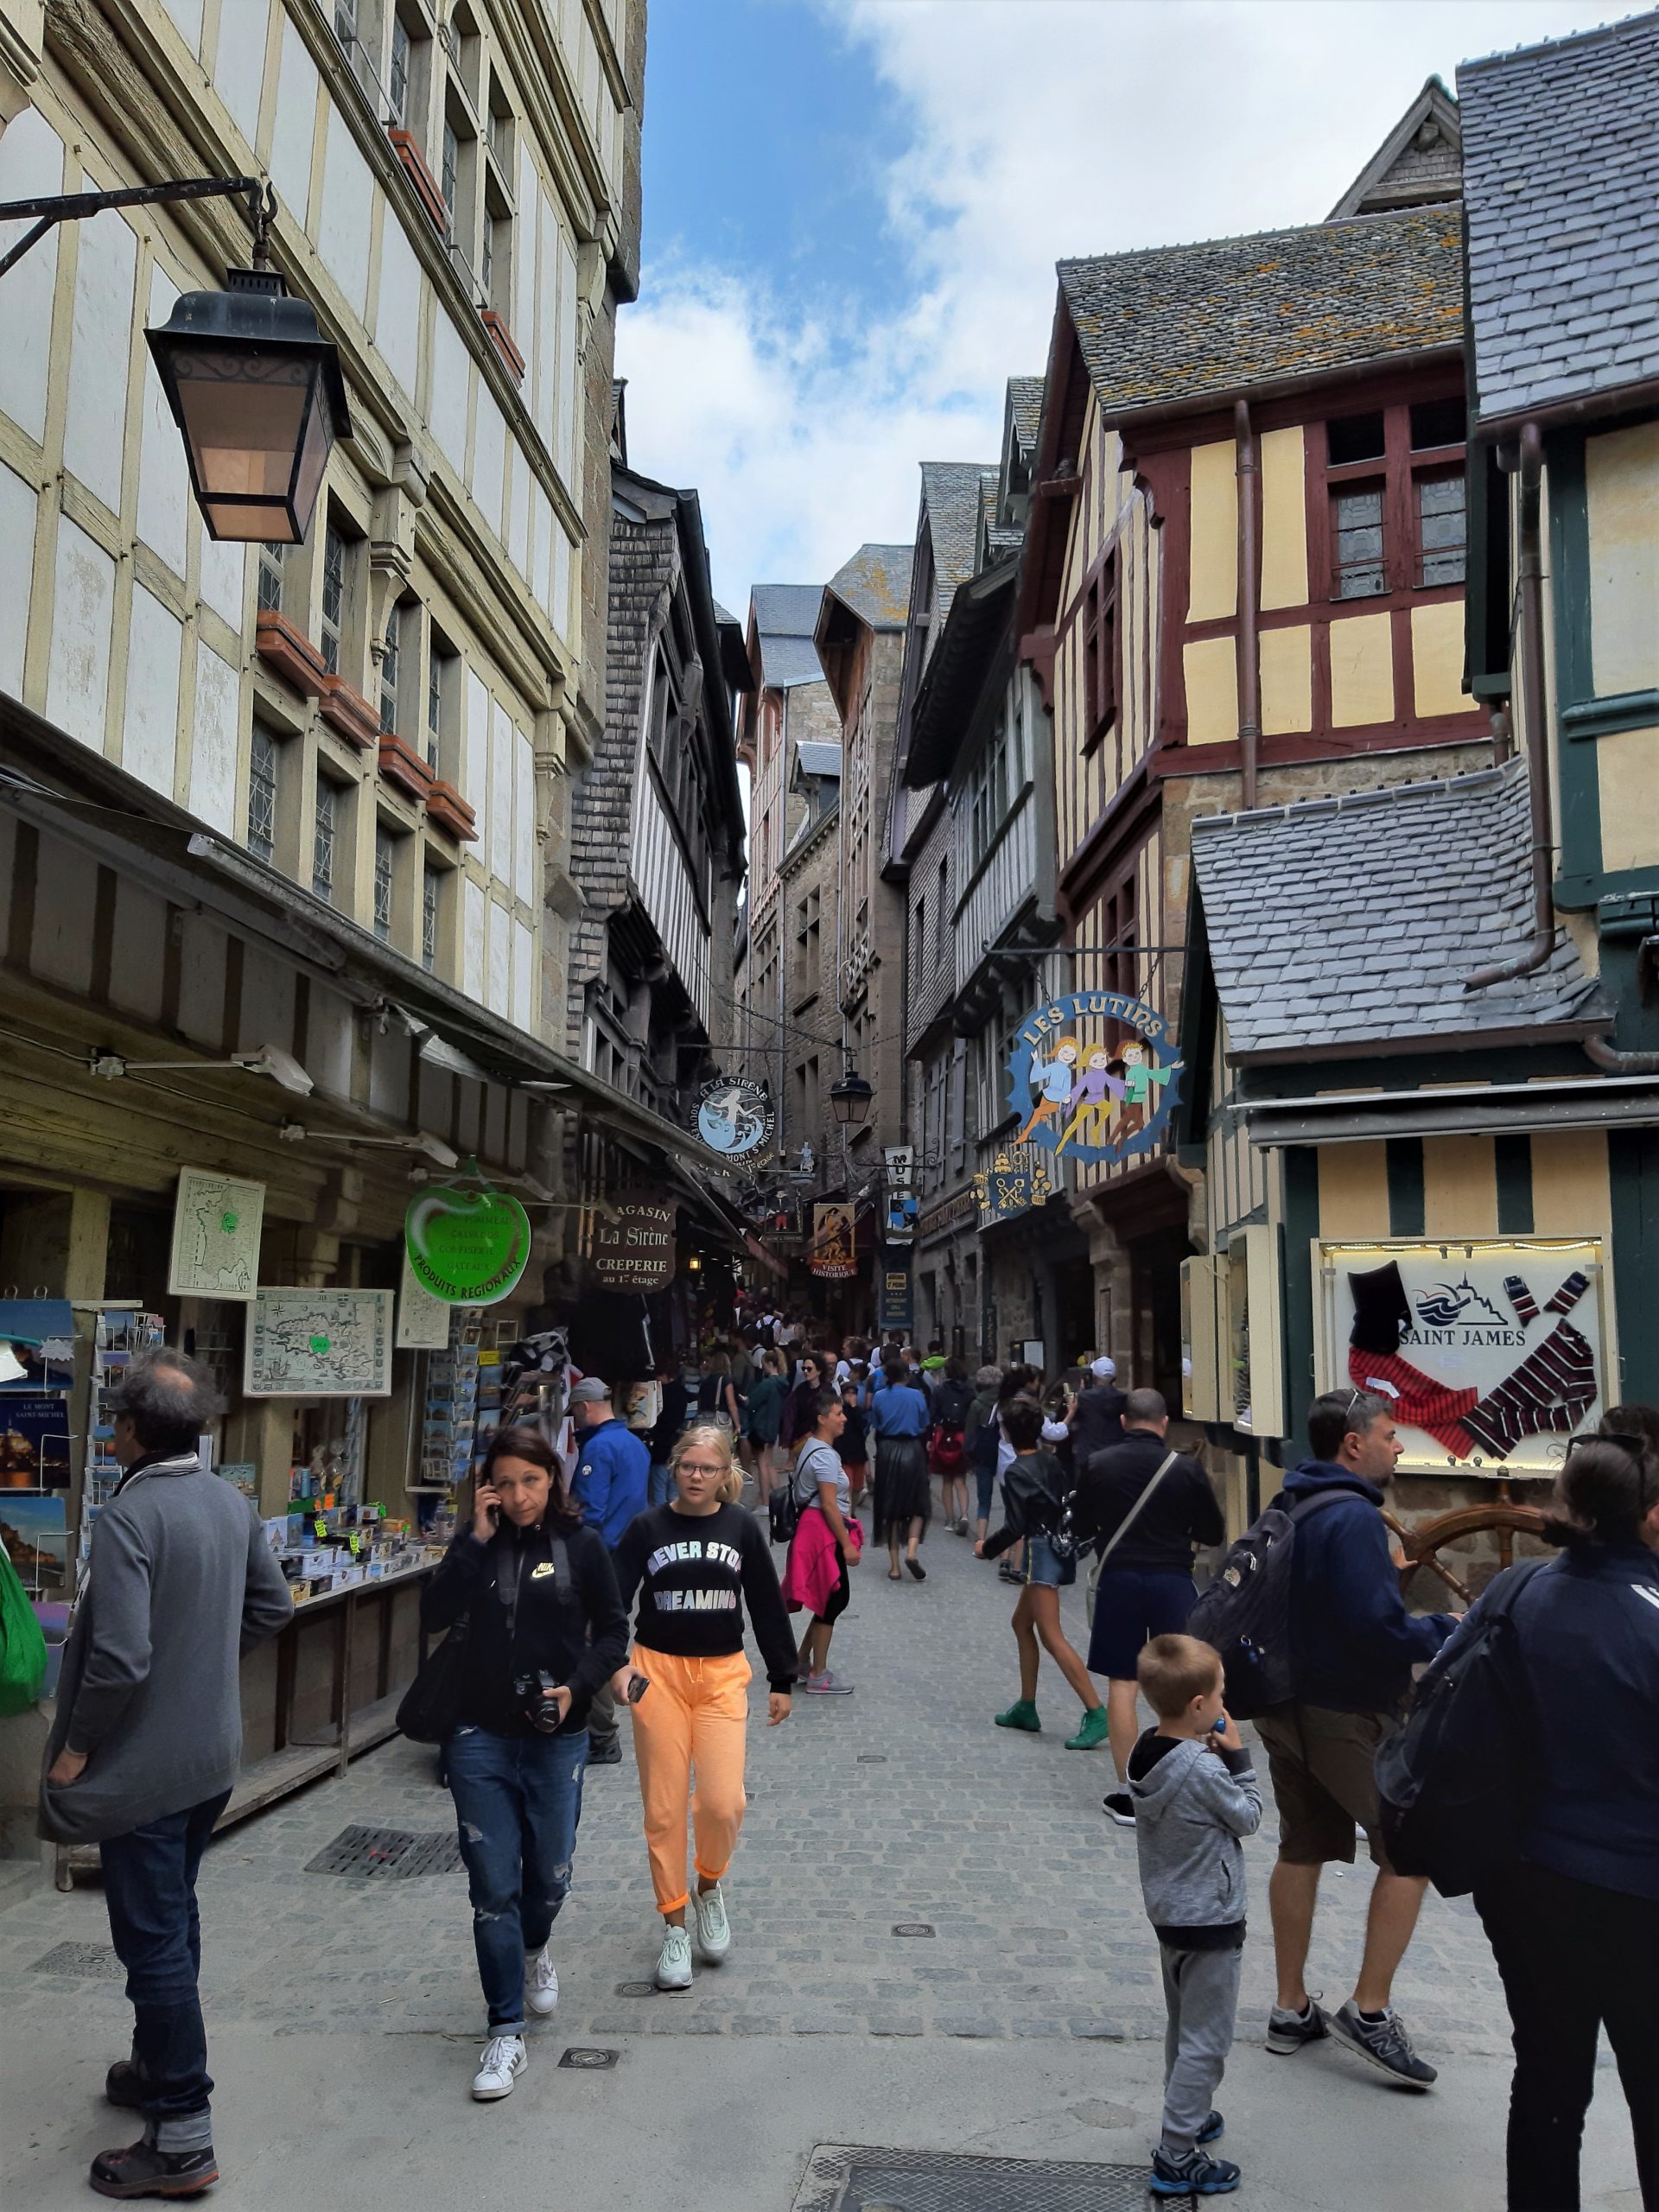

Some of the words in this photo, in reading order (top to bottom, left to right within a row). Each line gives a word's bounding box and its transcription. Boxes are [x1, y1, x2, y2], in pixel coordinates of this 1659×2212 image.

[1023, 1007, 1065, 1046] LES
[1072, 996, 1163, 1038] LUTINS
[758, 1111, 775, 1147] MICHEL
[603, 1205, 671, 1223] AGASIN
[599, 1227, 620, 1244] La
[626, 1226, 669, 1246] Sirène
[596, 1258, 667, 1272] CREPERIE
[812, 1268, 857, 1278] HISTORIQUE
[414, 1254, 457, 1297] PRODUITS
[461, 1258, 521, 1299] REGIONAUX
[632, 1274, 659, 1286] étage
[1400, 1330, 1455, 1345] SAINT
[1463, 1330, 1526, 1346] JAMES
